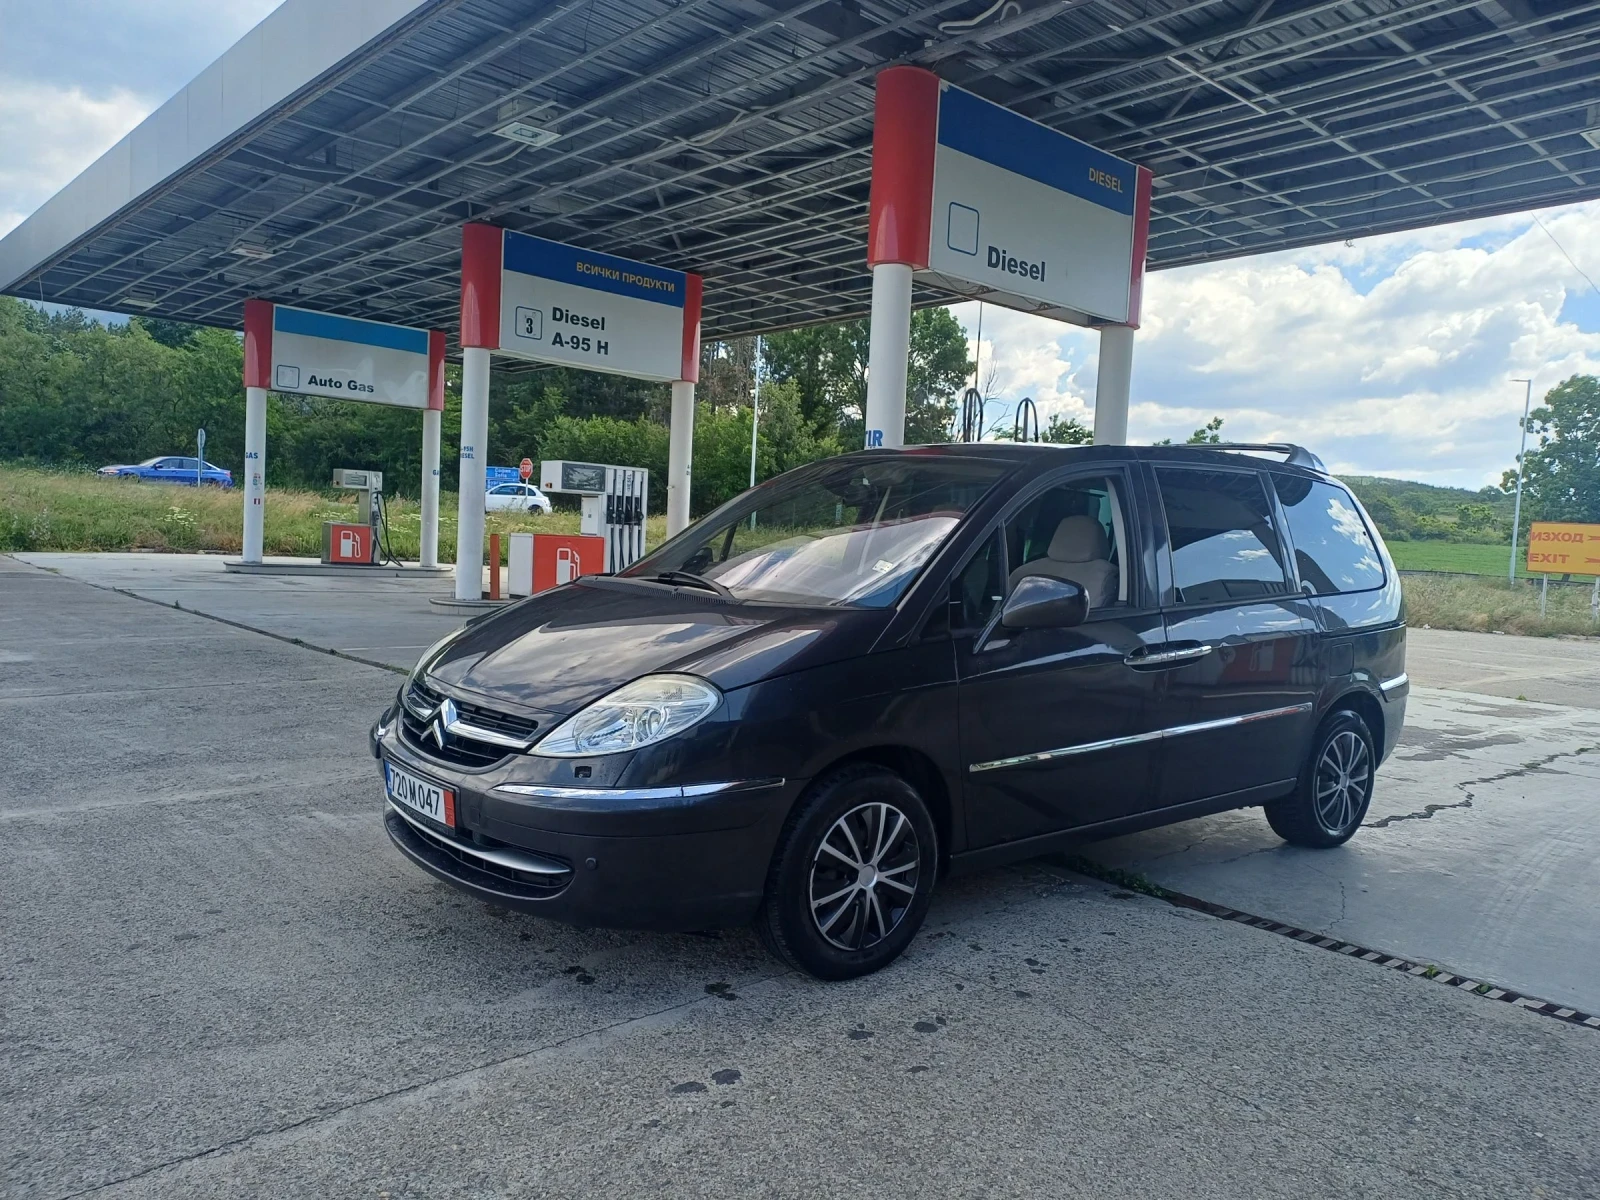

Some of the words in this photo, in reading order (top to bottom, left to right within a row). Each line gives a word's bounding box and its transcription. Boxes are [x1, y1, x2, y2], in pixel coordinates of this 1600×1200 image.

[1088, 167, 1123, 193] DIESEL
[987, 245, 1046, 282] Diesel
[576, 261, 620, 281] ВСИЧКИ
[622, 272, 675, 293] ПРОДУКТИ
[526, 317, 533, 334] 3
[552, 306, 605, 331] Diesel
[551, 332, 591, 352] A-95
[307, 374, 343, 389] Auto
[347, 380, 375, 393] Gas
[1531, 531, 1584, 543] ИЗХОД
[1529, 553, 1570, 564] EXIT
